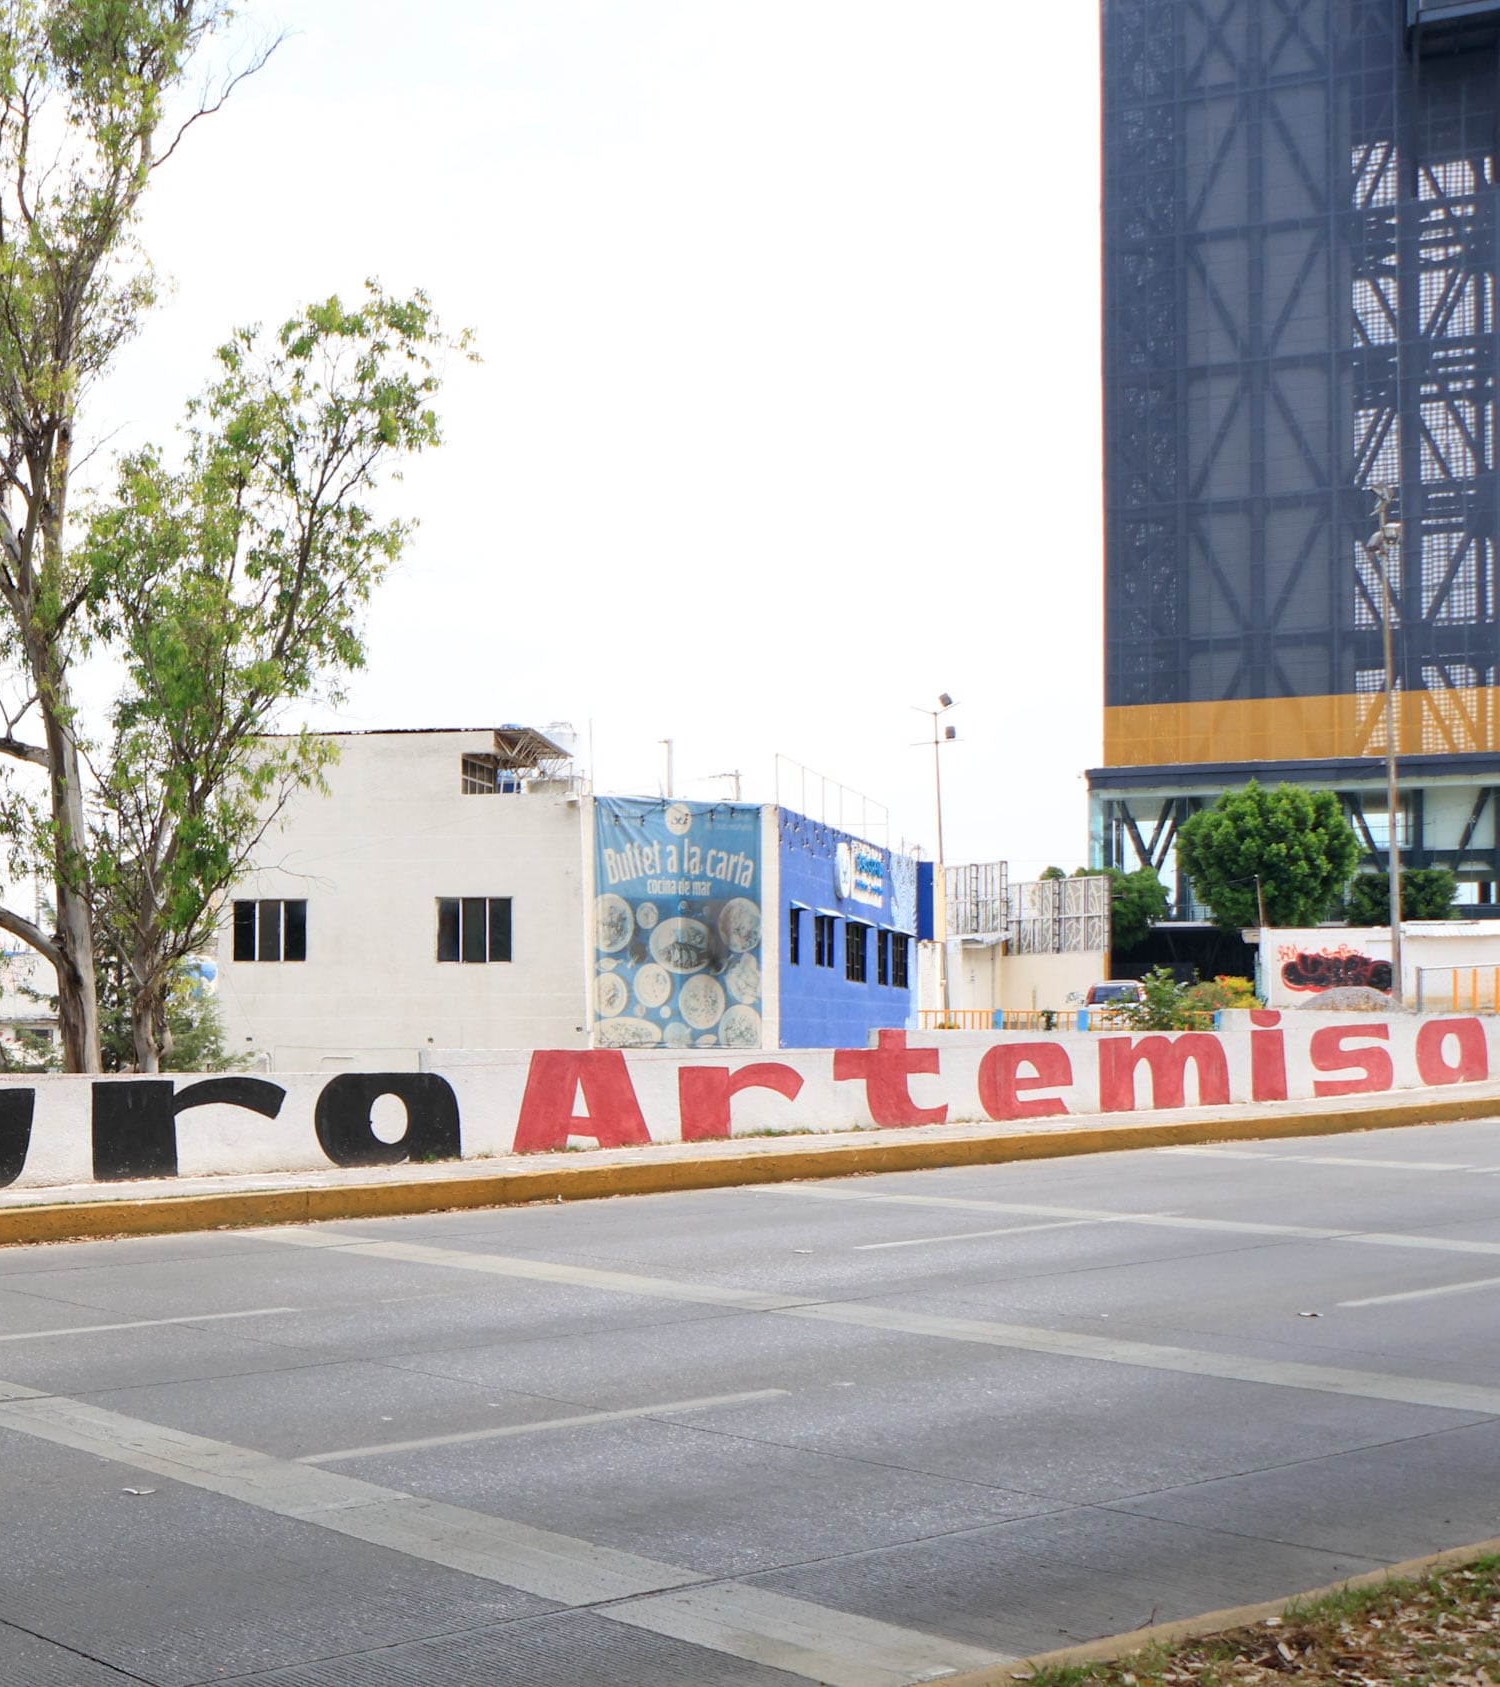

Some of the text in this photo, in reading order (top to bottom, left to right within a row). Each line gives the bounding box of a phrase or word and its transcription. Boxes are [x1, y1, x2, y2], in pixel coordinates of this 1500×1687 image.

[604, 838, 754, 888] Buffet a la carta
[647, 876, 711, 896] cocina de mar
[512, 1009, 1489, 1154] Artemisa
